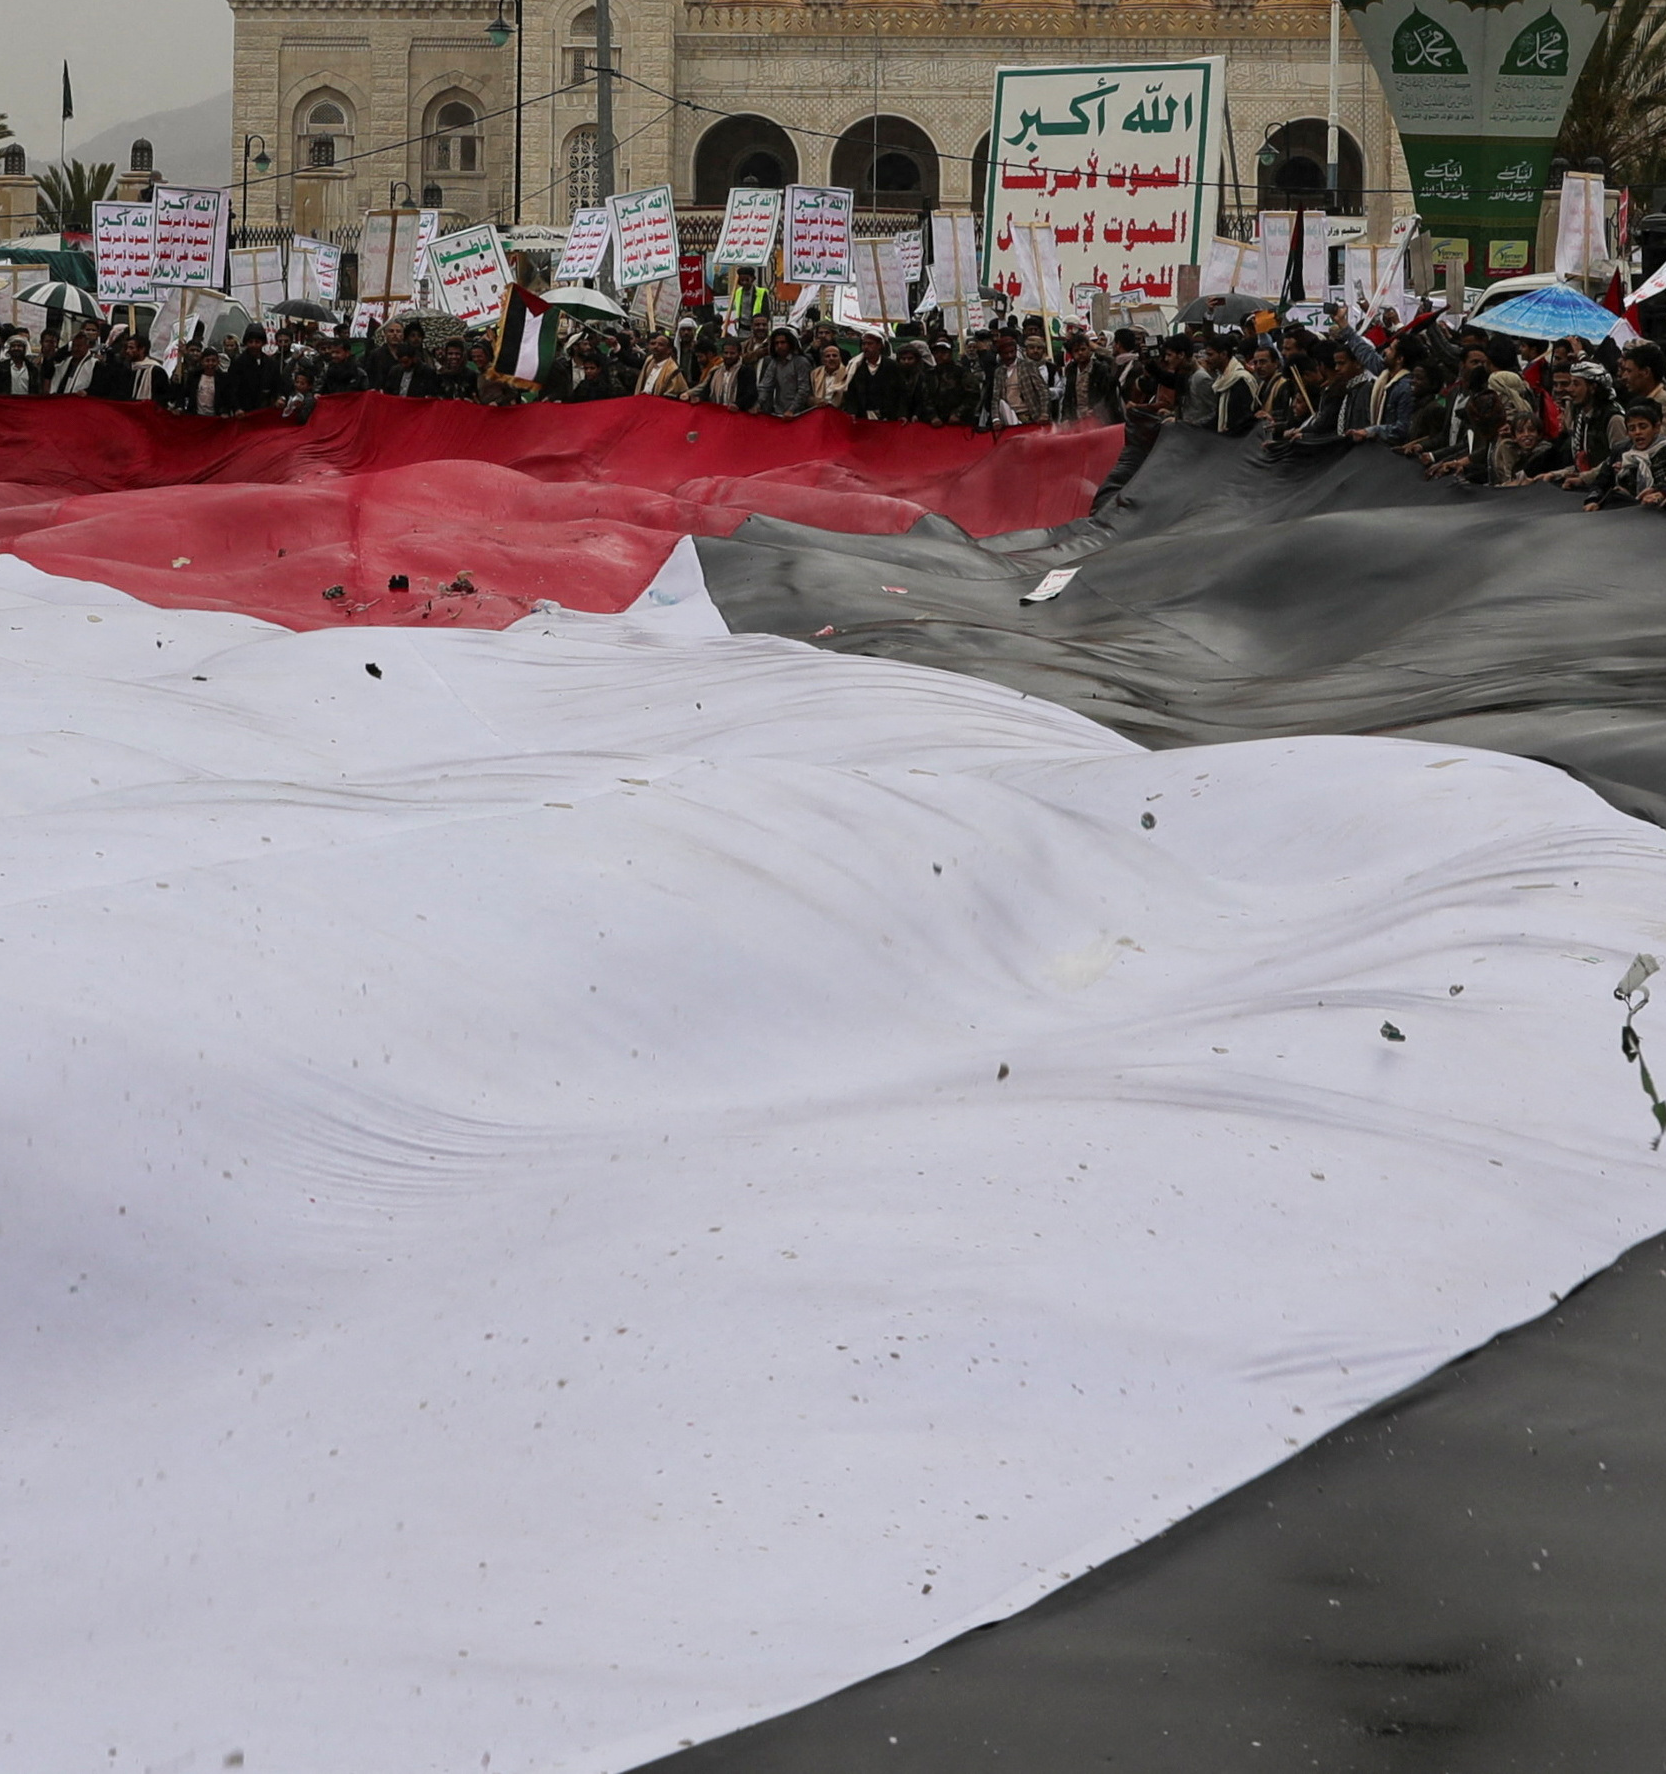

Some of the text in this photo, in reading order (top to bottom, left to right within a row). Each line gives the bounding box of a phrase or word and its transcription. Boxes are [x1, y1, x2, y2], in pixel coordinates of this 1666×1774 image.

[1002, 77, 1192, 153] الله أكبر
[1001, 148, 1191, 198] الموت لأمريكا
[159, 193, 216, 214] الله أكبر
[619, 194, 667, 221] الله أكبر
[735, 193, 775, 210] الله أكبر
[795, 192, 847, 212] الله أكبر
[98, 208, 152, 230] الله أكبر
[1104, 209, 1187, 252] الموت
[434, 234, 492, 269] قاطعوا
[184, 265, 209, 282] النصر
[653, 257, 674, 276] النصر
[824, 262, 846, 278] النصر
[1120, 263, 1173, 298] للعنة
